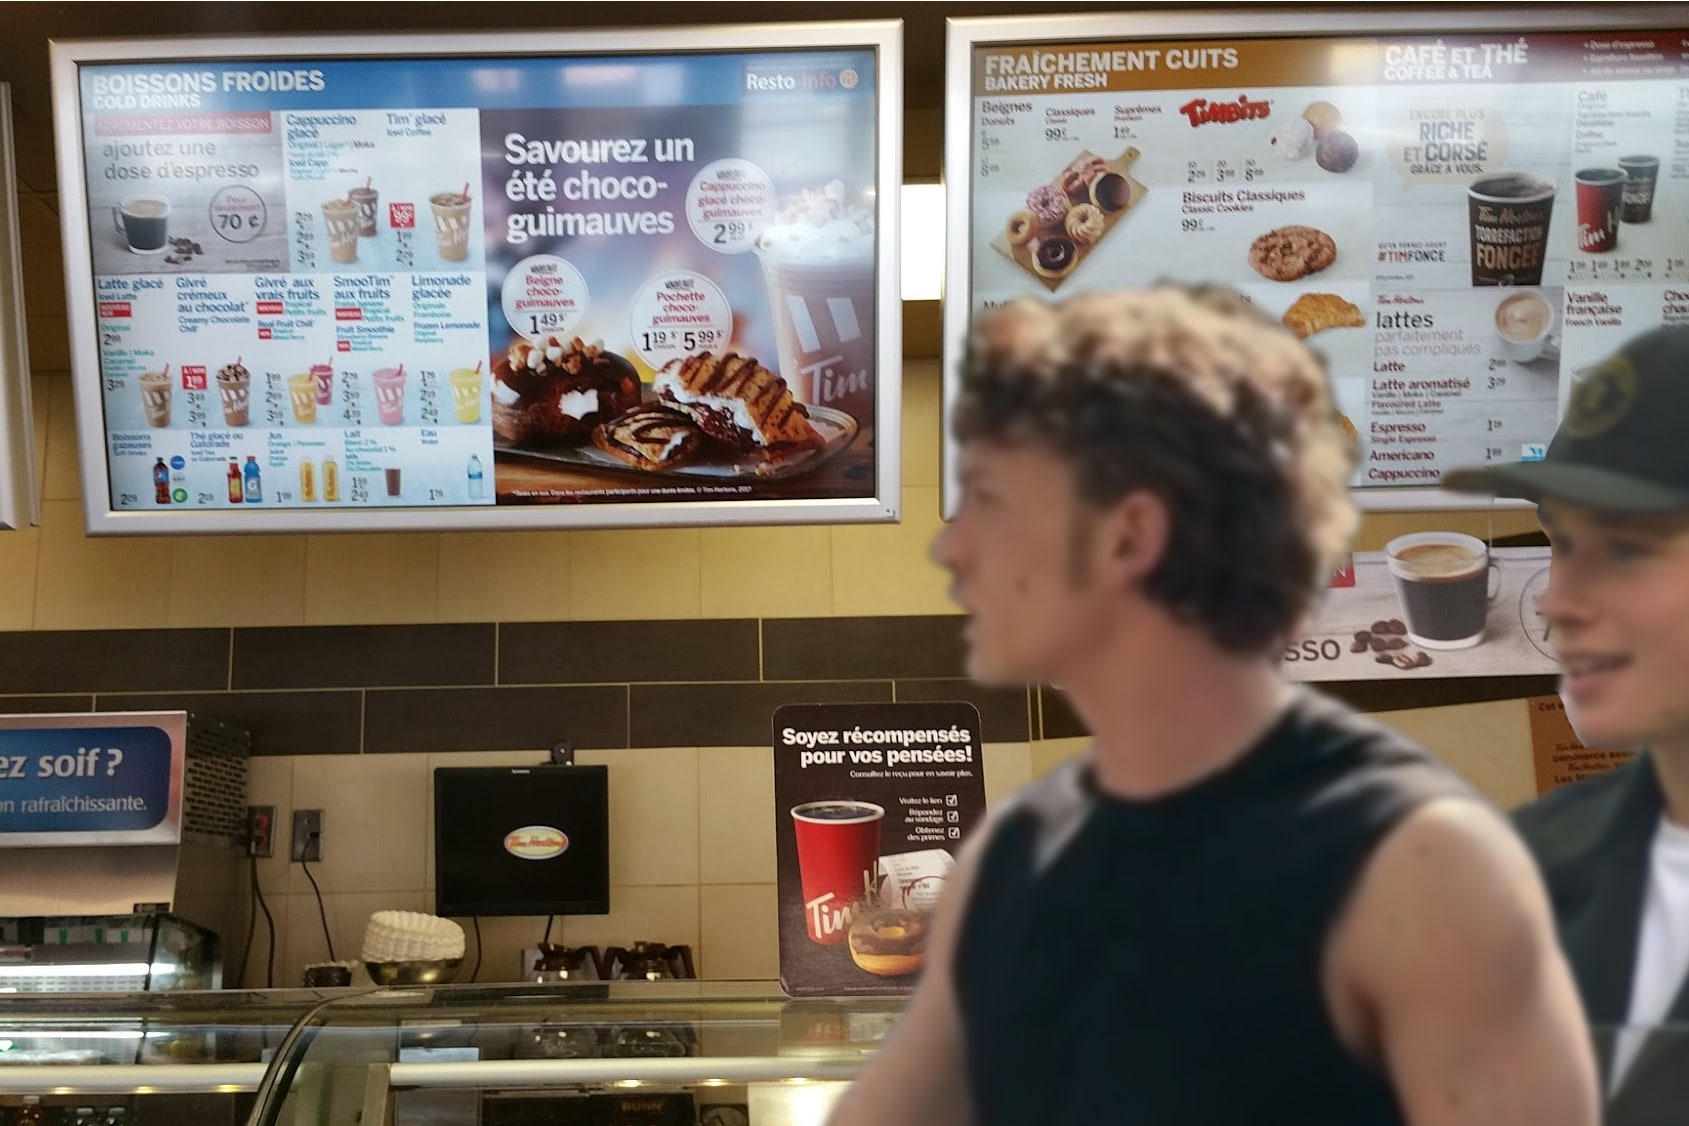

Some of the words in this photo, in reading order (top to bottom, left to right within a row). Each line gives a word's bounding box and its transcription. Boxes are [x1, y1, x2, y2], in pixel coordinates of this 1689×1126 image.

[1384, 39, 1447, 65] CAFÉ
[1451, 46, 1477, 65] ET
[1480, 37, 1529, 65] THÉ
[985, 50, 1161, 76] FRAÎCHEMENT
[1165, 48, 1240, 70] CUITS
[1384, 65, 1446, 80] COFFEE
[1447, 66, 1459, 80] &
[1461, 65, 1493, 80] TEA
[94, 72, 217, 95] BOISSONS
[222, 70, 326, 92] FROIDES
[745, 72, 797, 91] Resto
[984, 74, 1051, 92] BAKERY
[1054, 72, 1108, 88] FRESH
[93, 95, 137, 110] COLD
[140, 93, 201, 109] DRINKS
[981, 100, 1034, 115] Beignes
[1045, 107, 1096, 118] Classiques
[216, 116, 269, 130] BOISSON
[286, 114, 357, 128] Cappuccino
[414, 112, 447, 127] glacé
[981, 116, 1016, 127] Donuts
[287, 126, 319, 140] glacé
[1419, 121, 1475, 142] RICHE
[103, 140, 174, 161] ajoutez
[180, 142, 217, 156] une
[504, 132, 649, 165] Savourez
[654, 137, 695, 162] un
[1403, 146, 1423, 162] ET
[1424, 139, 1489, 162] CORSÉ
[104, 163, 152, 181] dose
[157, 161, 260, 183] d'espresso
[505, 168, 557, 201] été
[563, 168, 669, 201] choco-
[700, 181, 765, 193] Cappuccino
[1181, 189, 1234, 204] Biscuits
[1236, 188, 1306, 204] Classiques
[703, 208, 762, 221] guimauves
[218, 213, 242, 230] 70
[506, 206, 676, 245] guimauves
[97, 278, 129, 290] Latte
[131, 277, 164, 292] glacé
[176, 276, 207, 288] Givré
[255, 276, 287, 288] Givré
[292, 278, 314, 288] aux
[411, 274, 472, 287] Limonade
[525, 275, 564, 288] Beigne
[177, 289, 228, 301] crémeux
[255, 289, 285, 300] vrais
[287, 288, 320, 300] fruits
[334, 289, 355, 299] aux
[359, 288, 391, 299] fruits
[412, 289, 451, 302] glacée
[656, 291, 706, 302] Pochette
[1566, 291, 1608, 303] Vanille
[178, 304, 193, 313] au
[195, 301, 246, 313] chocolat
[515, 298, 576, 311] guimauves
[1566, 304, 1622, 316] française
[652, 315, 711, 326] guimauves
[1376, 311, 1435, 329] lattes
[1374, 329, 1464, 345] parfaitement
[1374, 345, 1402, 359] pas
[1402, 342, 1481, 358] compliqués
[1373, 361, 1406, 372] Latte
[1372, 379, 1406, 390] Latte
[1408, 377, 1471, 390] aromatisé
[1417, 400, 1442, 408] Latte
[420, 429, 438, 438] Eau
[1370, 422, 1426, 435] Espresso
[190, 432, 207, 441] Thé
[208, 431, 231, 442] glacé
[1398, 435, 1437, 445] Espresso
[1369, 449, 1435, 462] Americano
[1368, 467, 1441, 482] Cappuccino
[782, 727, 840, 748] Soyez
[843, 725, 972, 747] récompensés
[37, 747, 101, 779] soif
[800, 749, 846, 769] pour
[849, 749, 883, 764] vos
[887, 745, 974, 767] pensées!
[1552, 751, 1607, 763] commerce
[850, 769, 885, 778] Consultez
[884, 770, 892, 778] le
[892, 770, 908, 779] reçu
[908, 770, 924, 779] pour
[935, 769, 956, 777] savoir
[956, 769, 974, 778] plus.
[21, 795, 148, 814] rafraîchissante.
[899, 796, 919, 805] Visitez
[922, 796, 929, 804] le
[930, 796, 943, 804] lien
[909, 808, 943, 817] Répondez
[914, 815, 945, 825] sondage
[915, 826, 945, 834] Obtenez
[621, 1101, 663, 1112] BUNN
